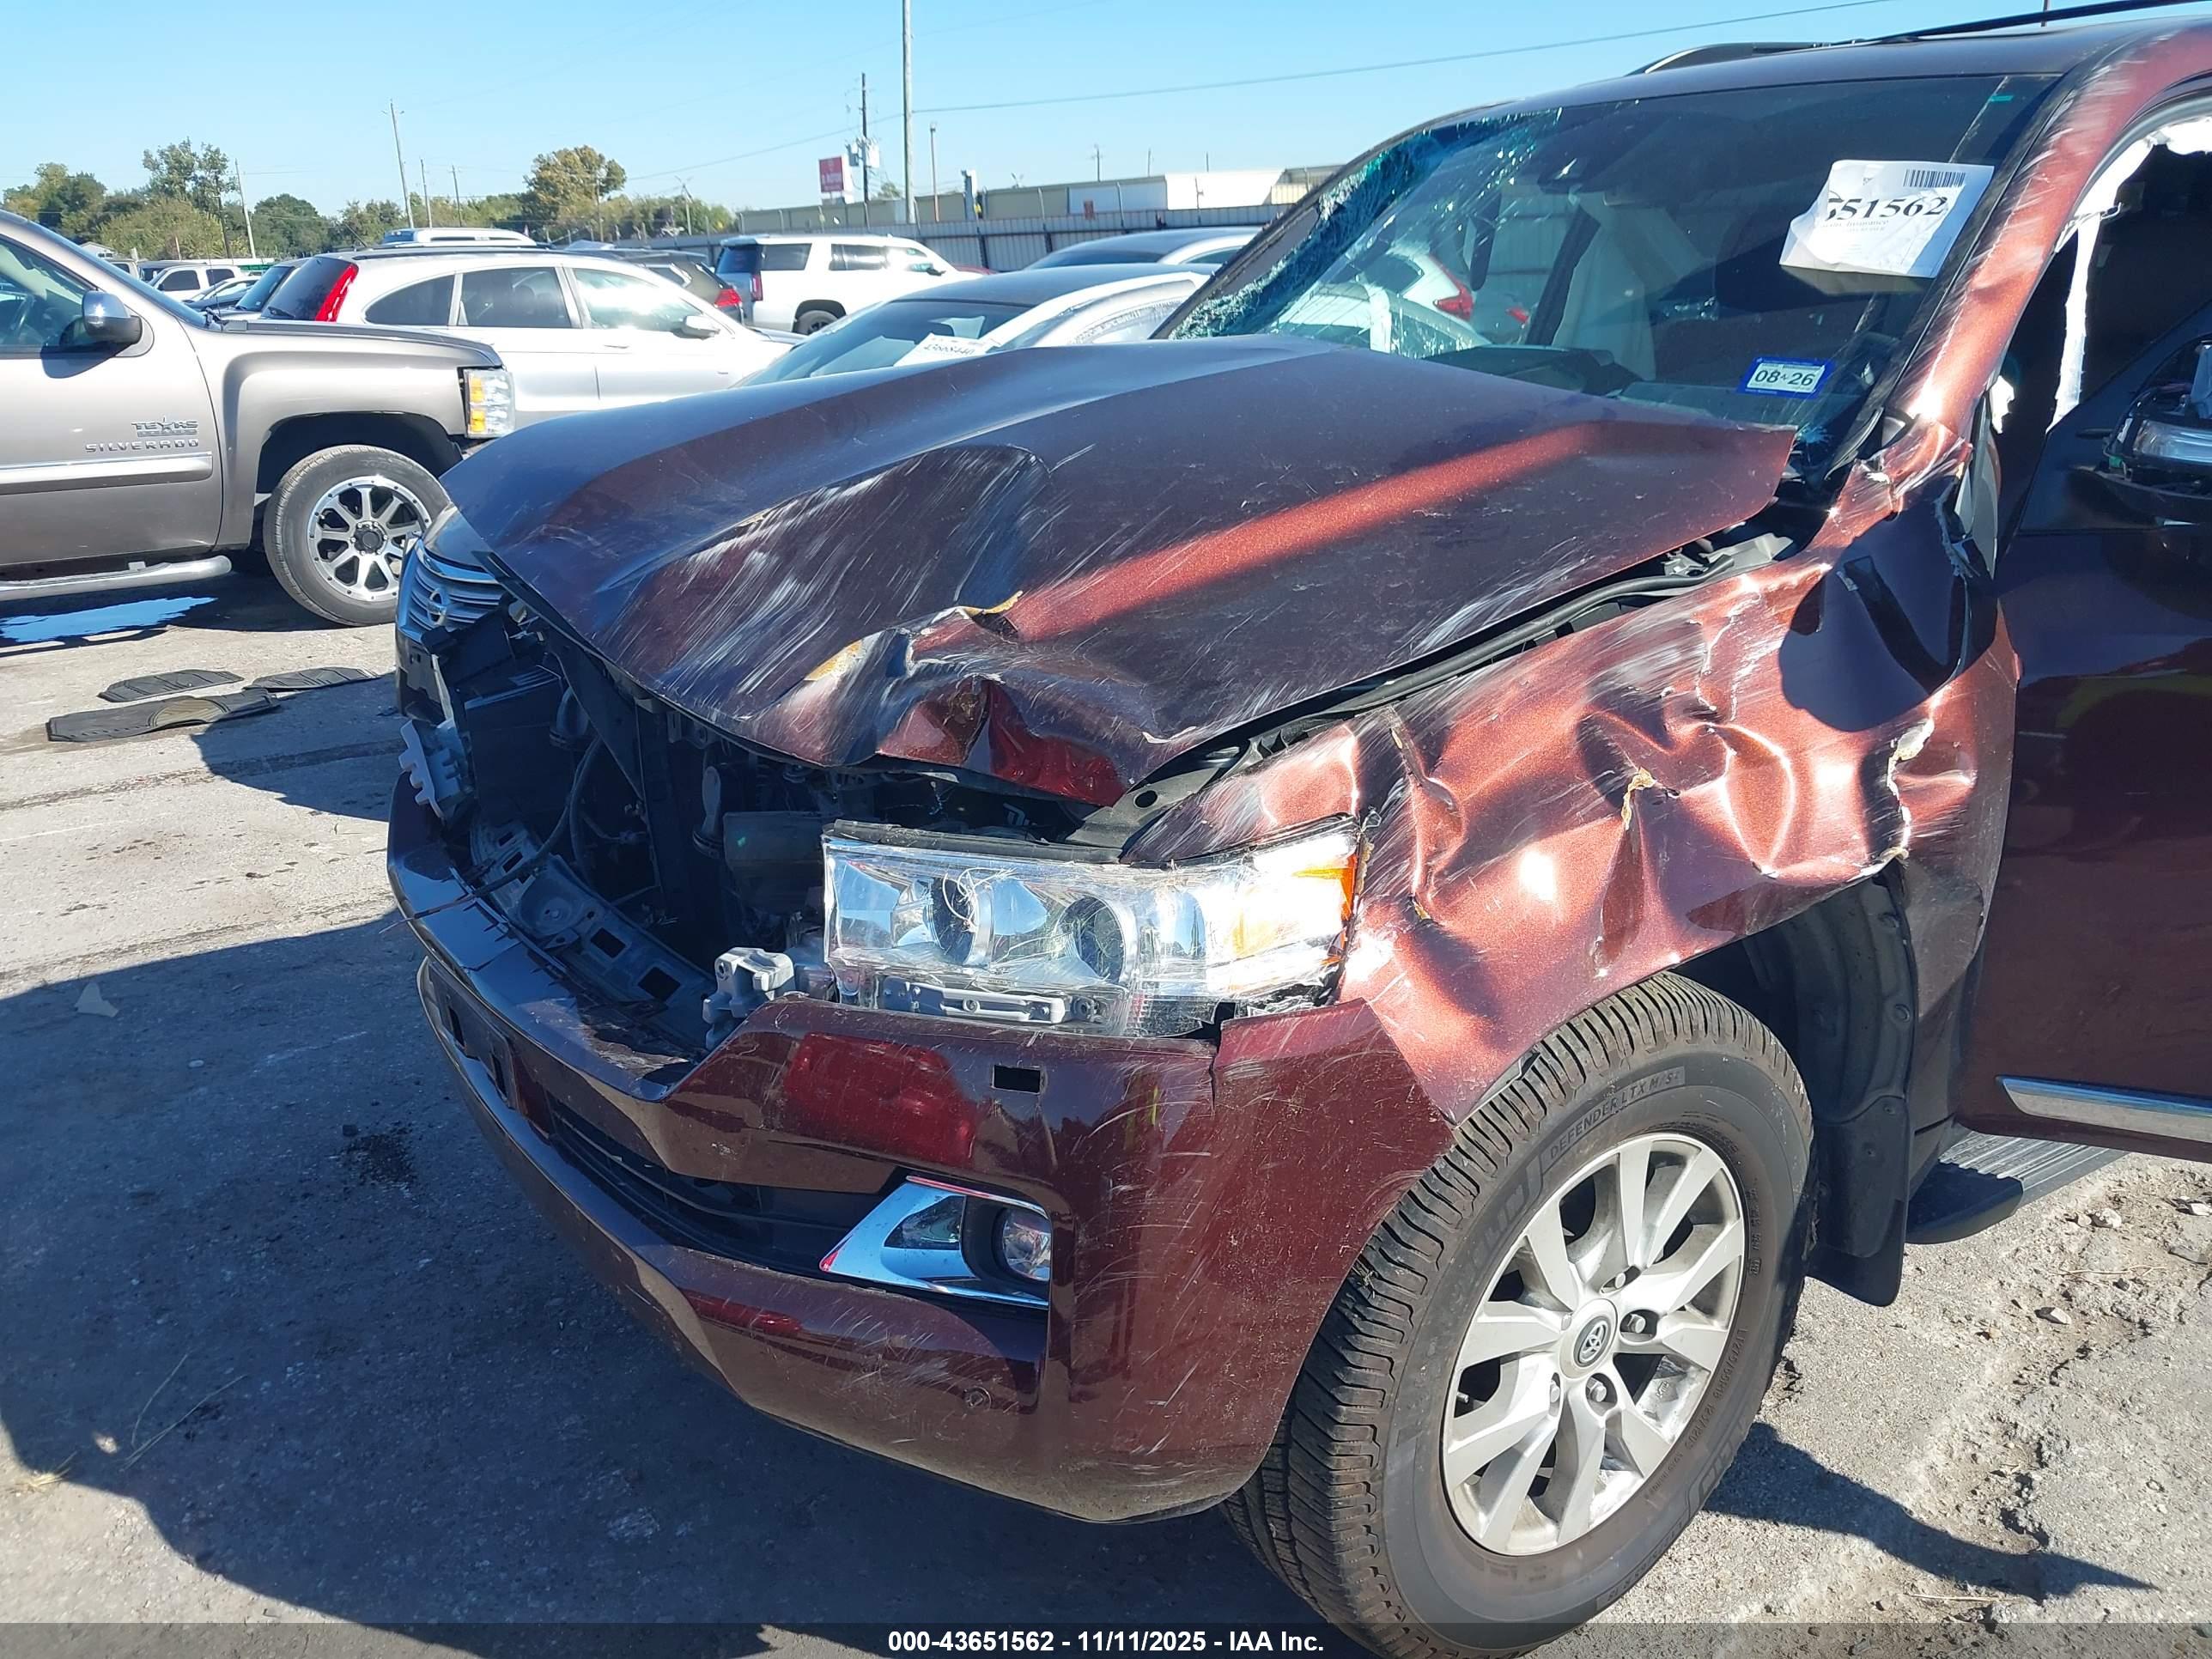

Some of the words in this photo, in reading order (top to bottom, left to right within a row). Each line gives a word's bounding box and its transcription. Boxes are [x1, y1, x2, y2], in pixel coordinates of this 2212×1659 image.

[85, 439, 199, 453] SILVERADO
[1548, 1097, 1620, 1159] DEFENDER
[1621, 1081, 1647, 1103] LTX
